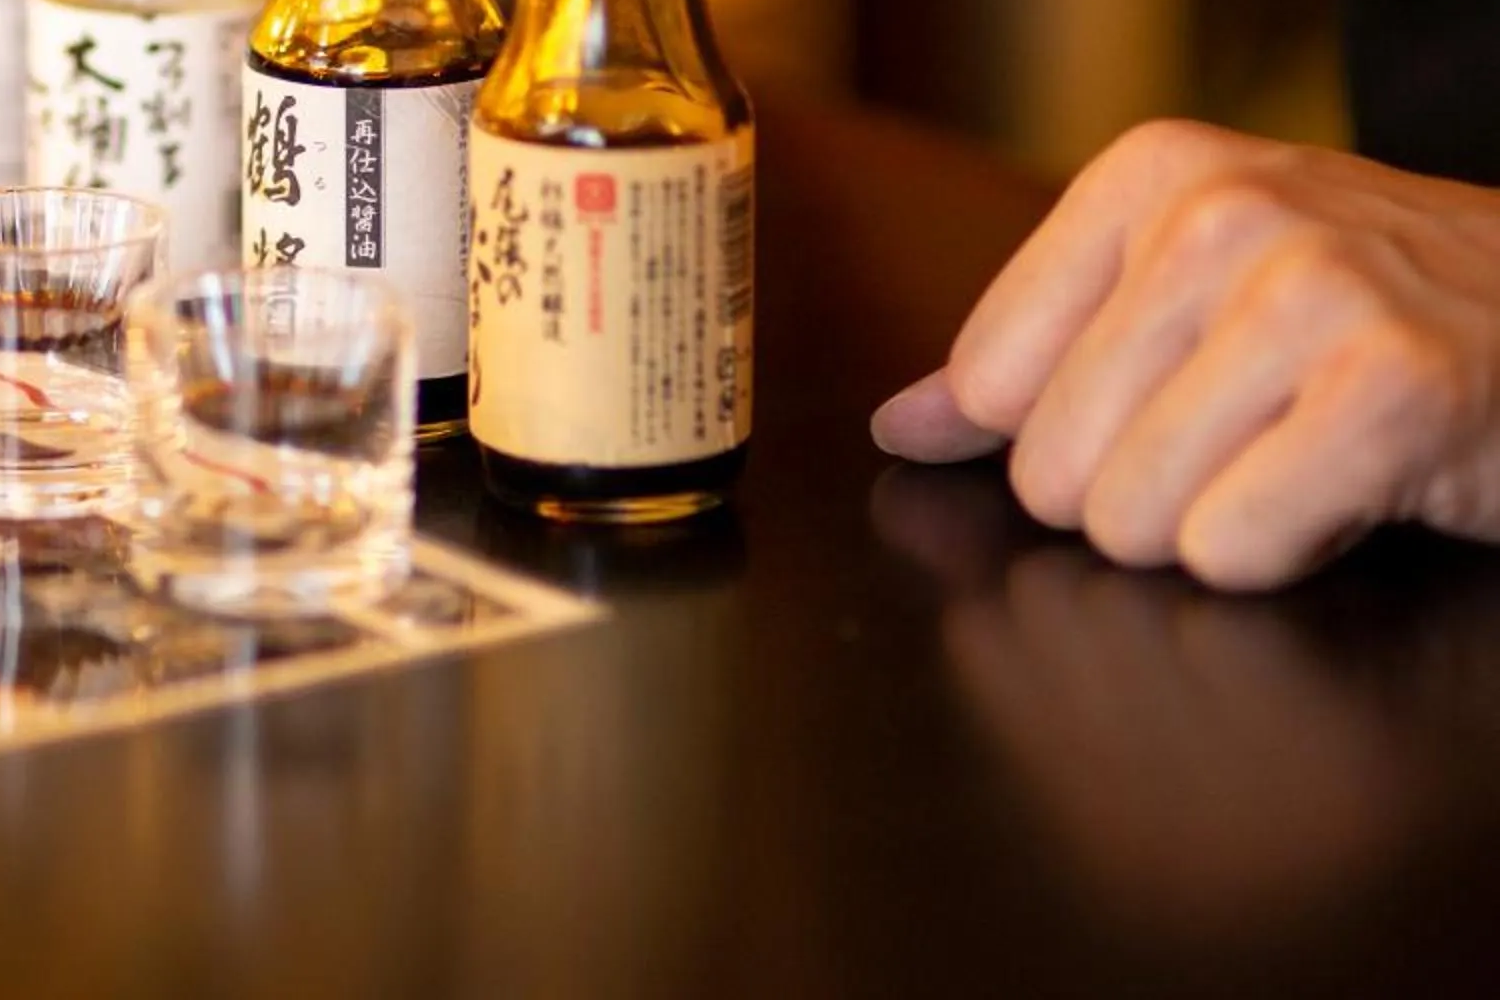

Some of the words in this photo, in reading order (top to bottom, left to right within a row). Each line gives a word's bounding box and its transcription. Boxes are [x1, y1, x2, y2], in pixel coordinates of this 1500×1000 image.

[350, 119, 379, 260] 再仕込醤油
